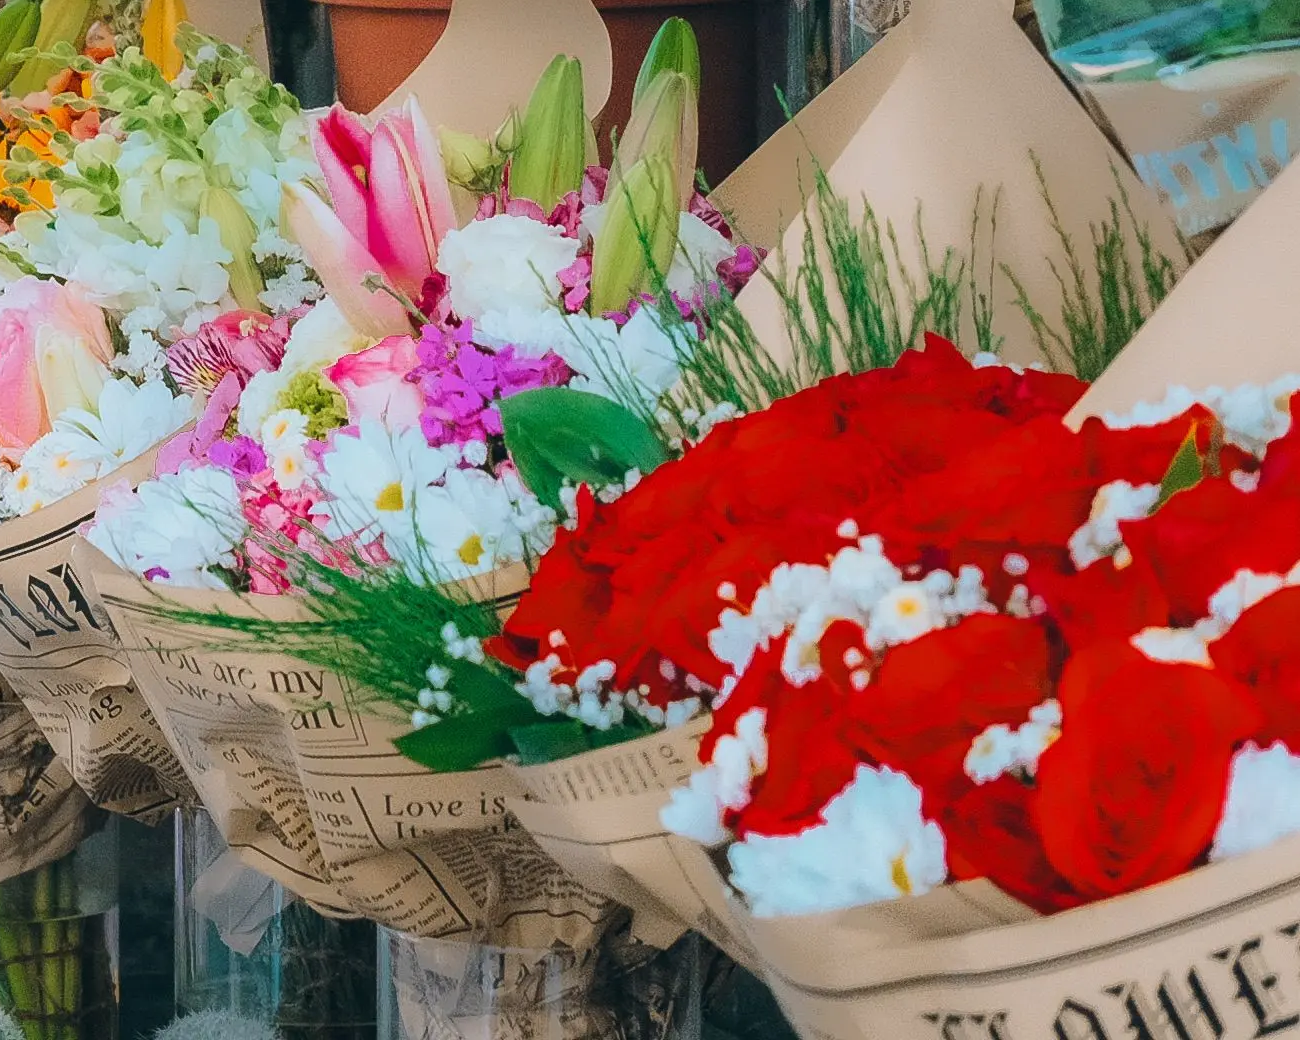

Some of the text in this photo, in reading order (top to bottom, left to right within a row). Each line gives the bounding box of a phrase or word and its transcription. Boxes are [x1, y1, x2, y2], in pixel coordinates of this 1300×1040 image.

[144, 636, 325, 701] You are my
[39, 679, 89, 698] Love
[384, 791, 508, 818] Love is
